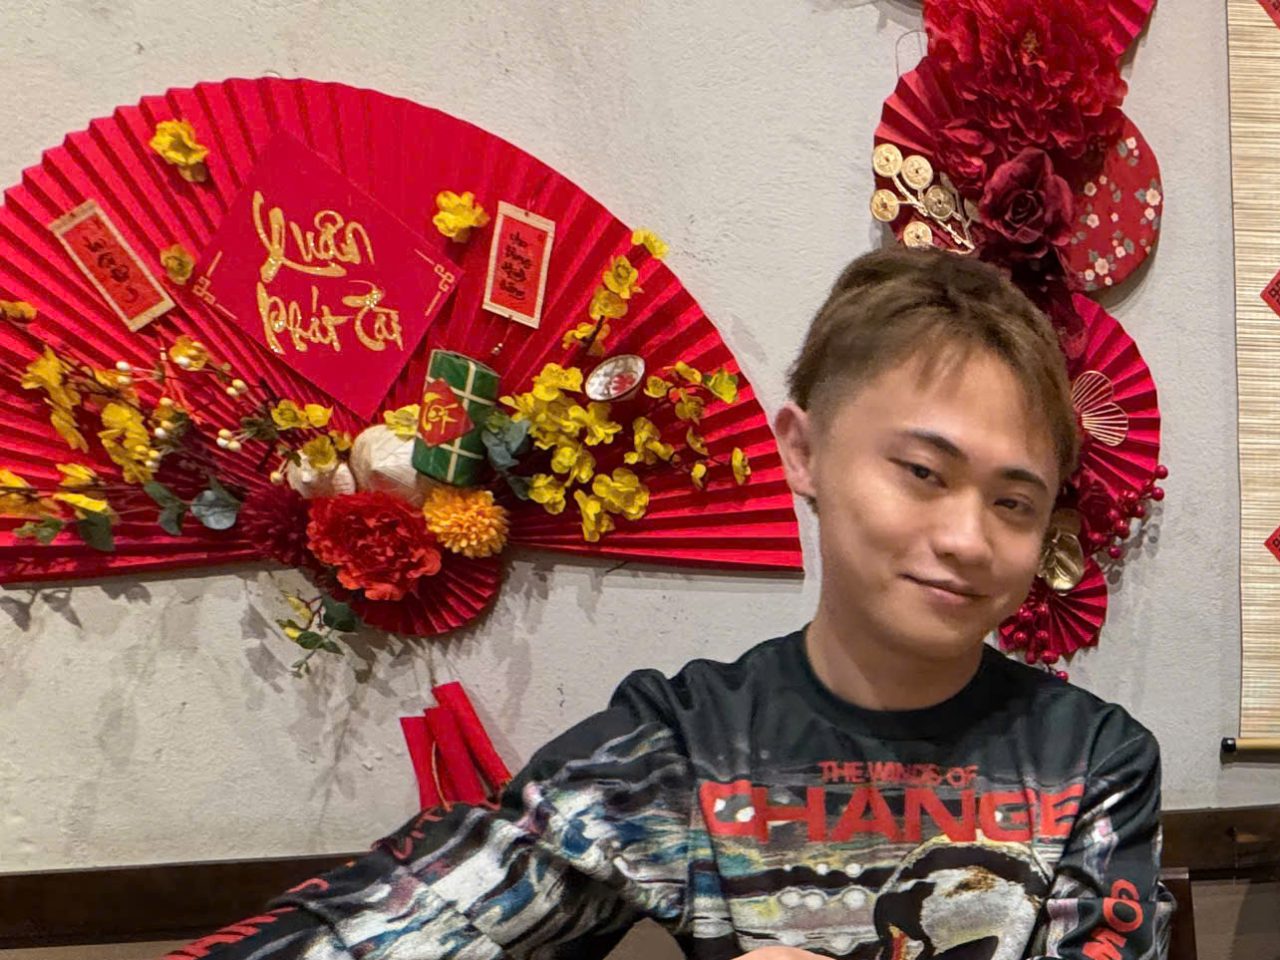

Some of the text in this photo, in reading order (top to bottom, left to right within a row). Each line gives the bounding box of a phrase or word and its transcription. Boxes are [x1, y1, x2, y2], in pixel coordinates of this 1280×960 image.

[252, 191, 375, 283] Xuân
[256, 282, 354, 355] Phát
[817, 760, 978, 788] THE WINDS OF
[700, 779, 1085, 844] CHANGE
